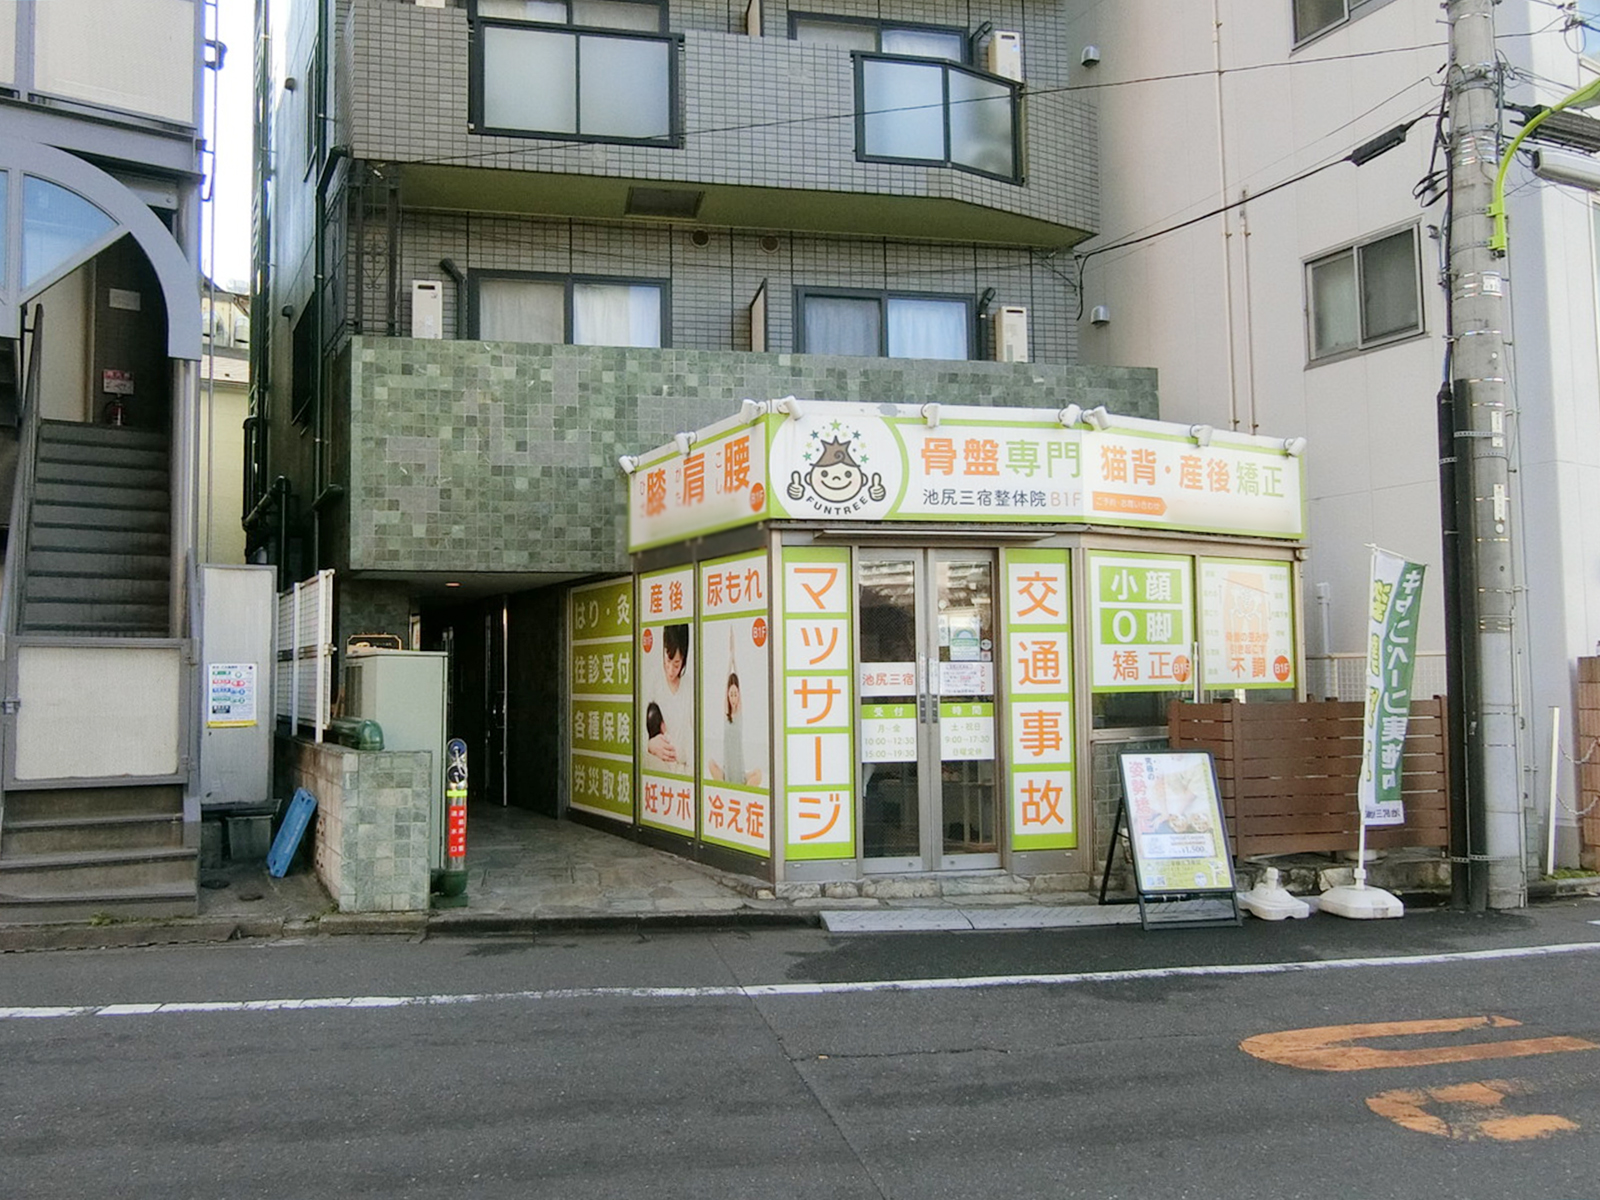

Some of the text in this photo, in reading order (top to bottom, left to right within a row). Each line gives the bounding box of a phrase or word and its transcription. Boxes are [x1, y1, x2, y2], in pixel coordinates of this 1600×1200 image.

[683, 451, 705, 507] 肩
[723, 435, 751, 494] 腰
[920, 436, 1083, 479] 骨盤専門
[1100, 444, 1285, 499] 猫背・産後矯正
[806, 495, 869, 516] FUNTREE
[922, 488, 1082, 508] 池尻三宿整体院 B1F
[649, 580, 683, 614] 産後
[706, 567, 762, 607] 尿もれ
[1110, 568, 1172, 601] 小顔
[575, 594, 630, 629] はり・灸
[1112, 609, 1173, 644] O脚
[753, 625, 766, 639] B1F
[574, 653, 630, 685] 往診受付
[861, 672, 915, 687] 池尻三宿
[1112, 650, 1173, 681] 矯正
[1231, 657, 1266, 679] 不調
[1274, 663, 1290, 674] B1F
[873, 706, 905, 718] 受付
[951, 705, 983, 717] 時間
[1016, 570, 1065, 827] 交通事故
[574, 709, 630, 744] 各種保険
[574, 764, 630, 803] 労災取扱
[644, 782, 691, 821] 妊サポ
[708, 794, 765, 839] 冷え症
